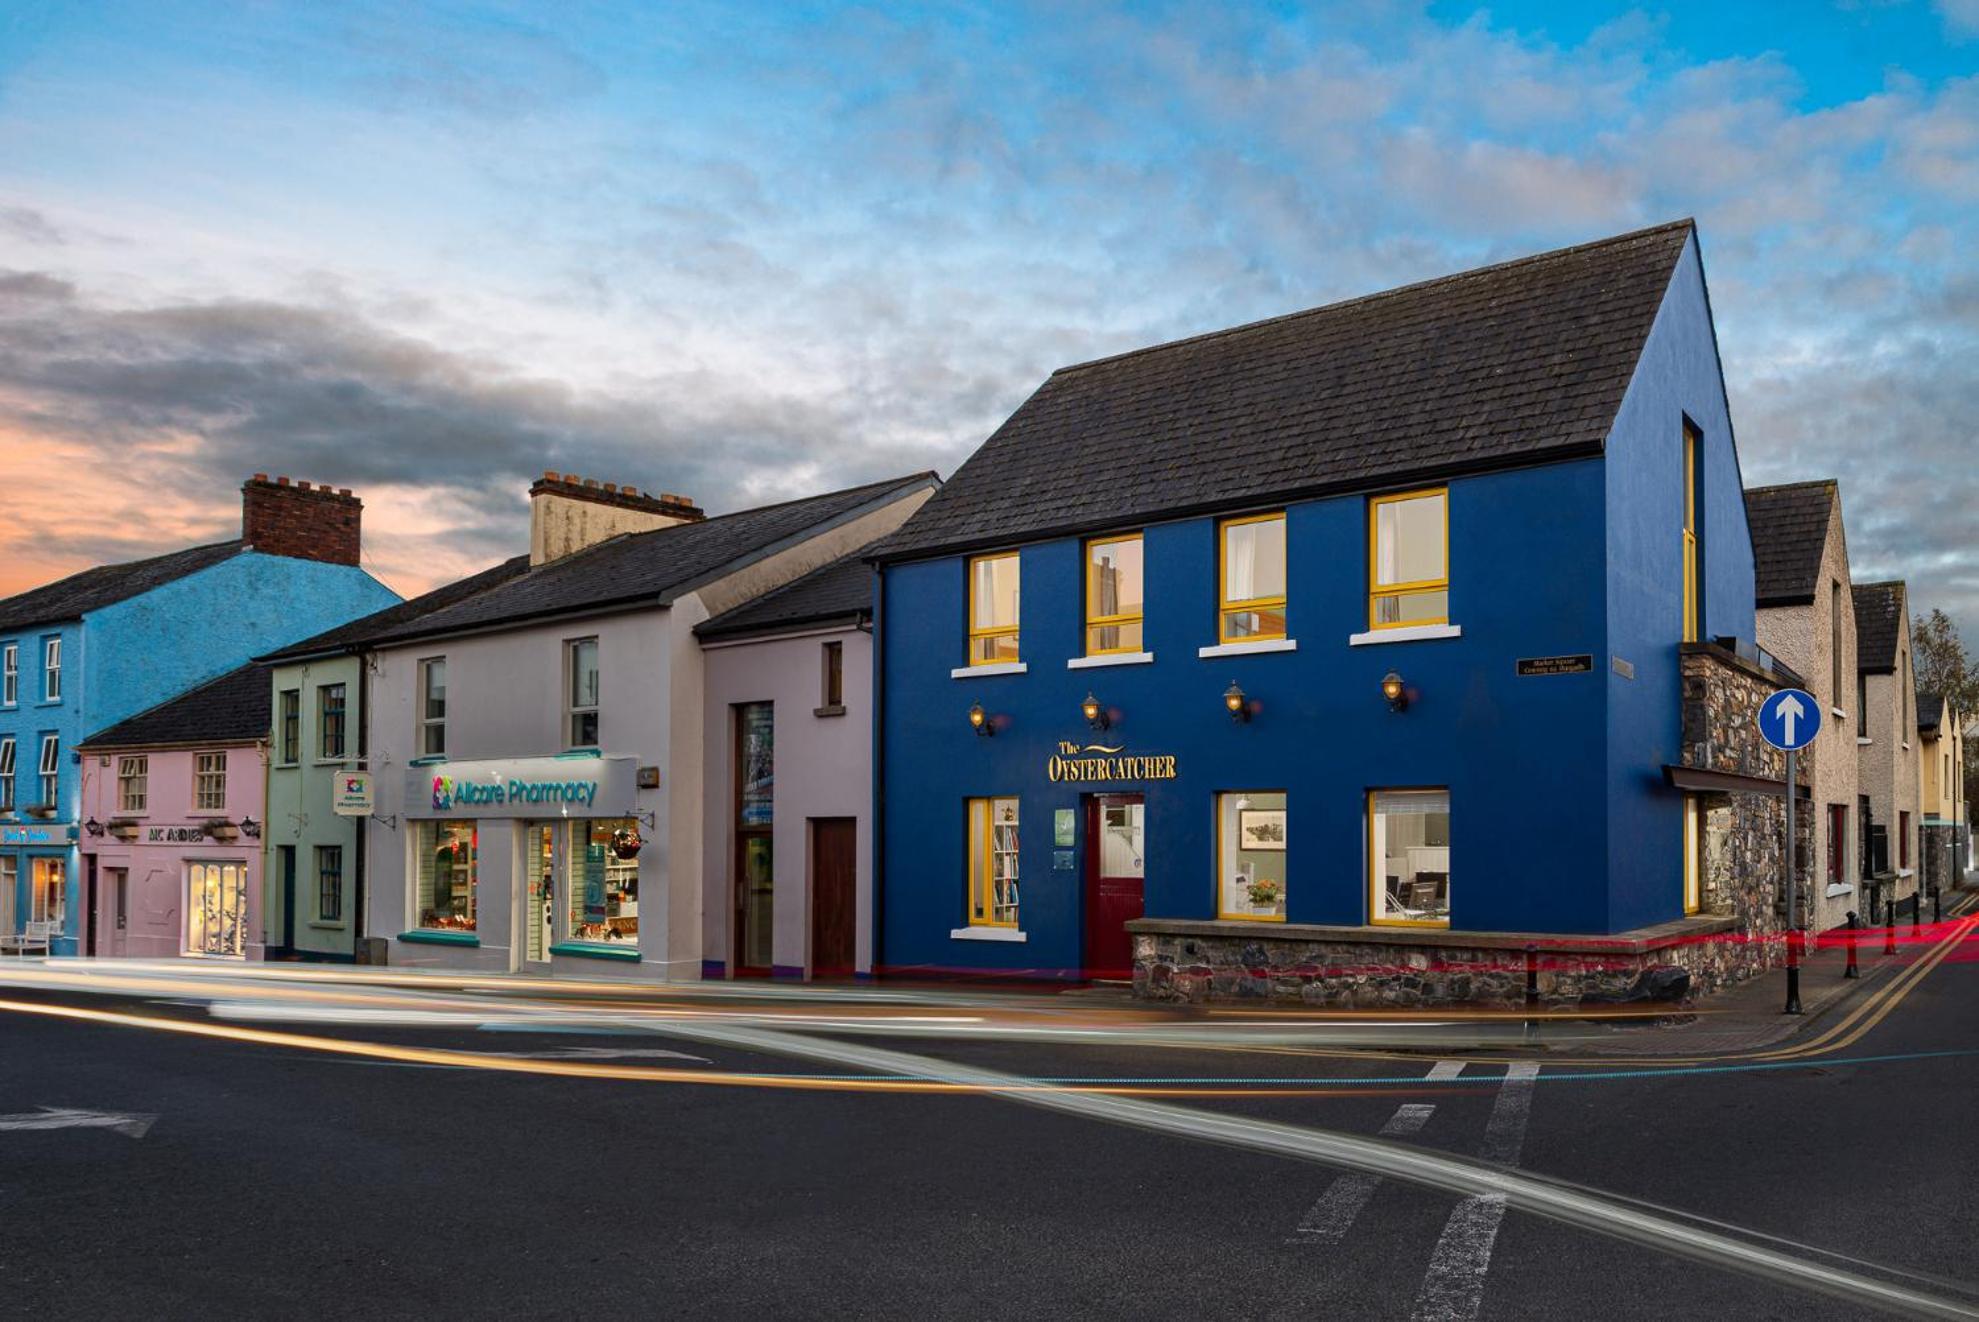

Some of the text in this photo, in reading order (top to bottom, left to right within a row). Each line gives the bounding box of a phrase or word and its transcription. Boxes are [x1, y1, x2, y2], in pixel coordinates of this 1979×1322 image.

[1058, 740, 1080, 755] The
[1048, 754, 1177, 782] OYSTERCATCHER
[454, 778, 597, 808] Allcare Pharmacy
